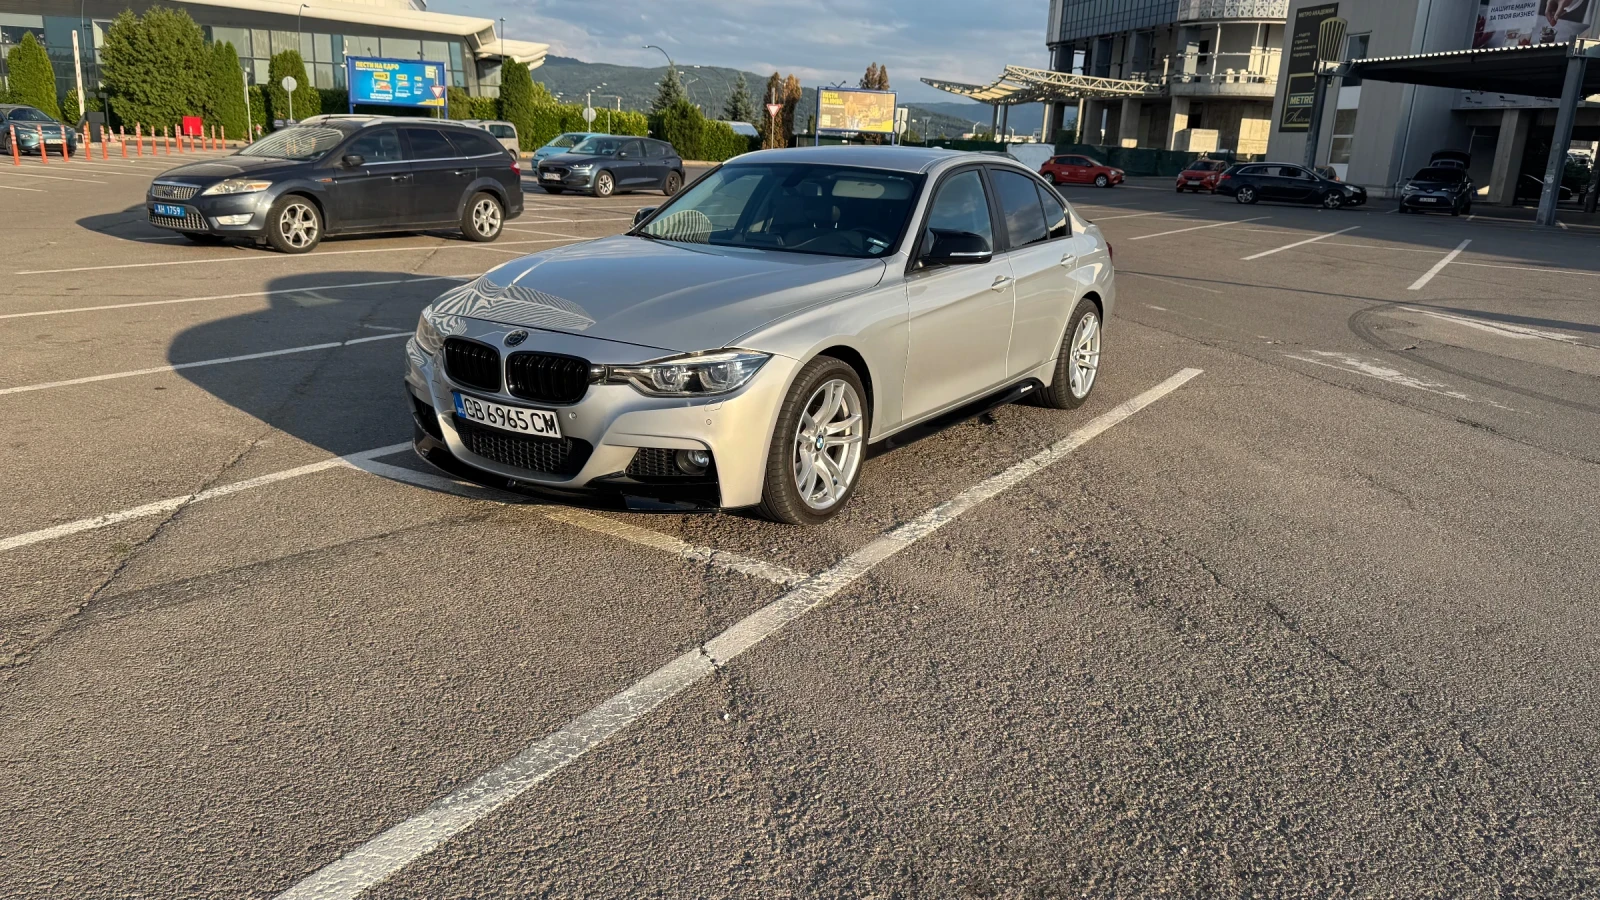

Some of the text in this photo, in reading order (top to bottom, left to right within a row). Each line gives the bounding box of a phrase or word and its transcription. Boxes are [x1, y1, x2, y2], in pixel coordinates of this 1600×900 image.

[1512, 10, 1535, 18] БИЗНЕС
[1290, 96, 1314, 104] METRO
[167, 206, 180, 215] 1759
[464, 398, 558, 435] CB 6965 CM
